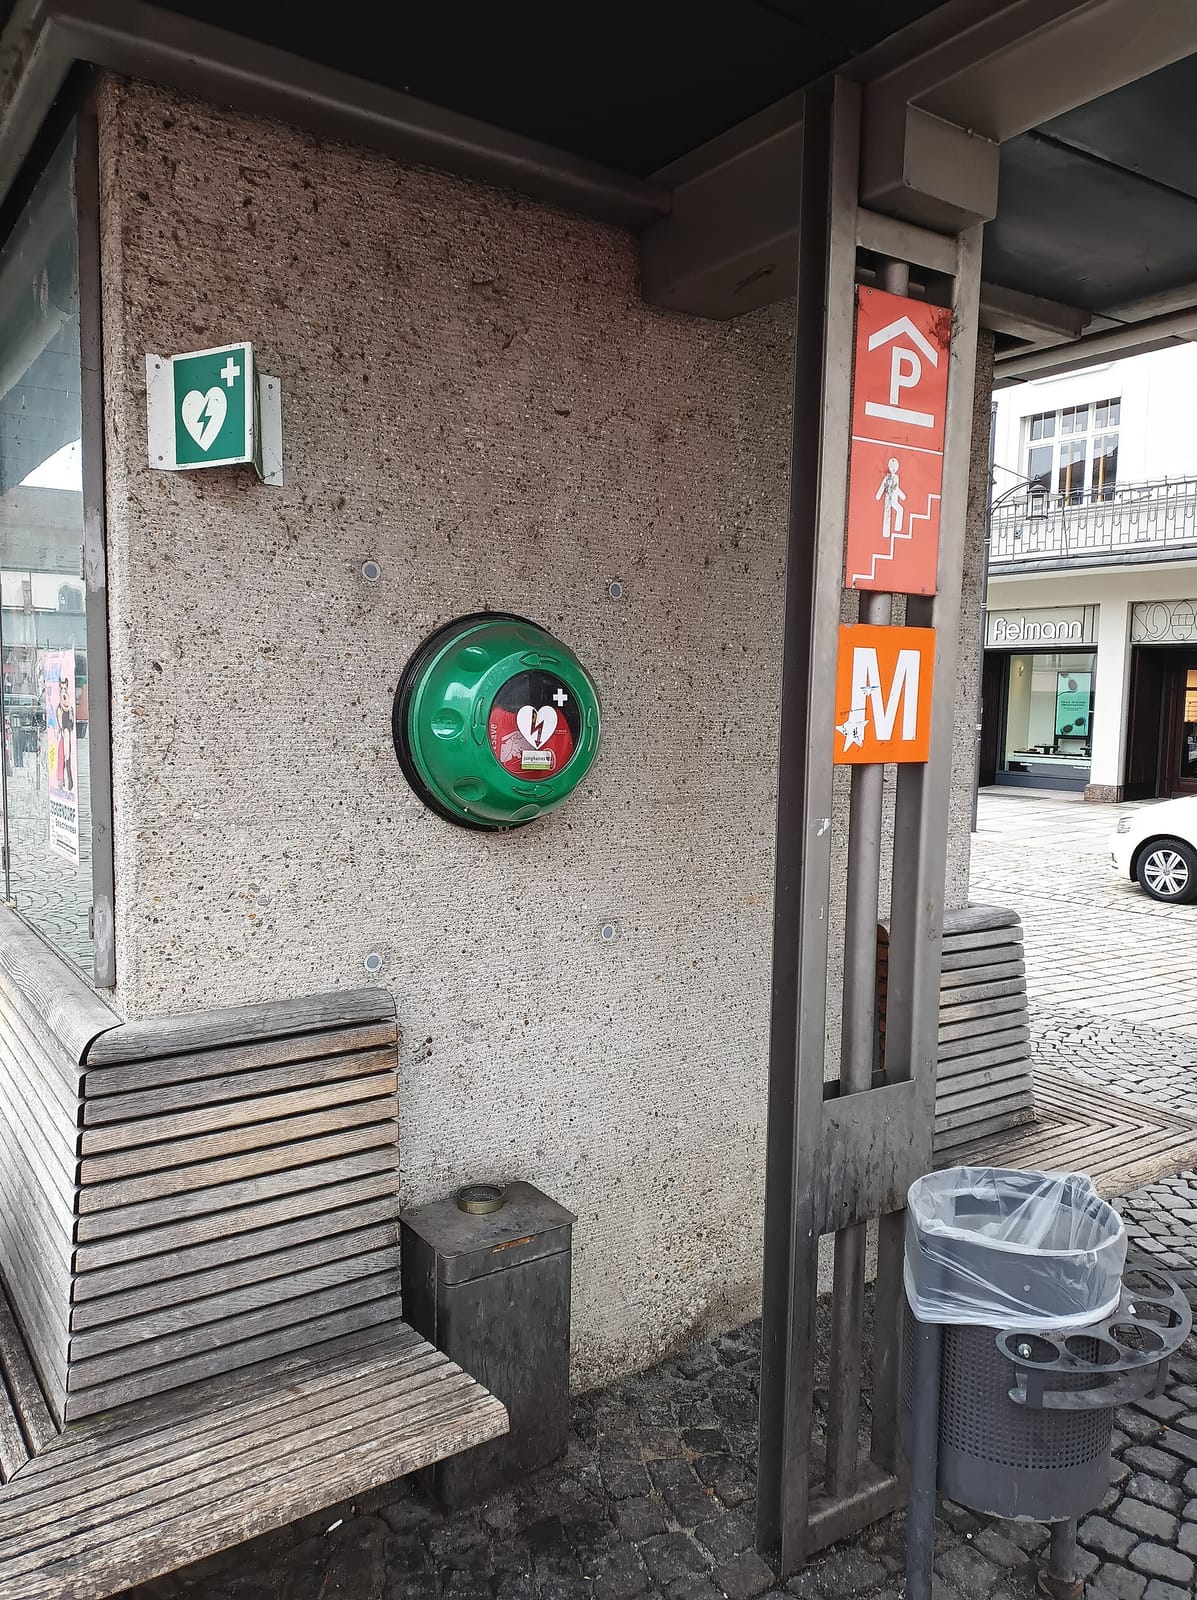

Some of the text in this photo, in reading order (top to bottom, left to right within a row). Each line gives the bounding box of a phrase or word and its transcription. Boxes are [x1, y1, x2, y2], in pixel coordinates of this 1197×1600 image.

[890, 345, 922, 405] P
[994, 616, 1083, 641] fielmann
[851, 647, 921, 741] M
